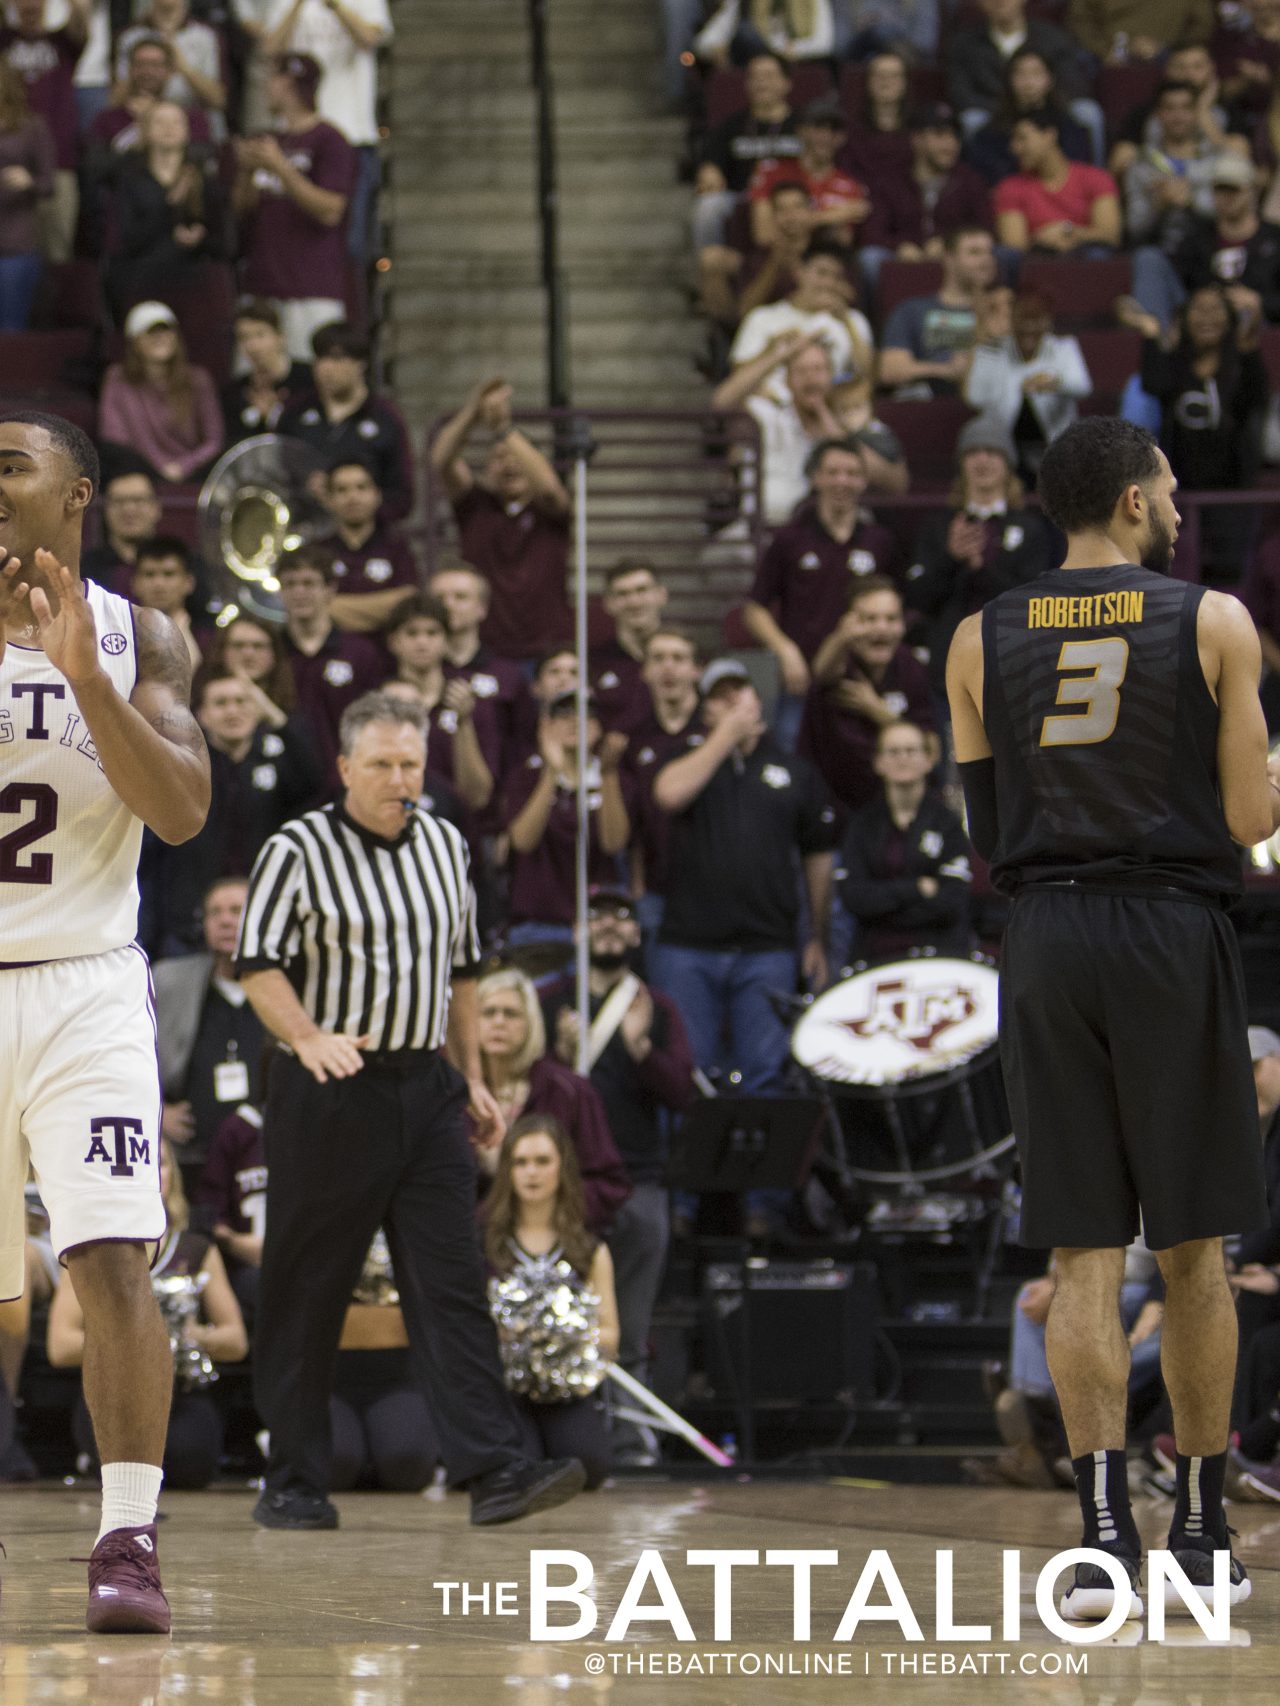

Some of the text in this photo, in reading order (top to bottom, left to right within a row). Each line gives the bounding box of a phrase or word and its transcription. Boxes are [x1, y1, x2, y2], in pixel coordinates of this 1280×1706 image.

[1027, 590, 1145, 629] ROBERTSON
[102, 635, 126, 654] SEC
[1039, 636, 1130, 748] 3
